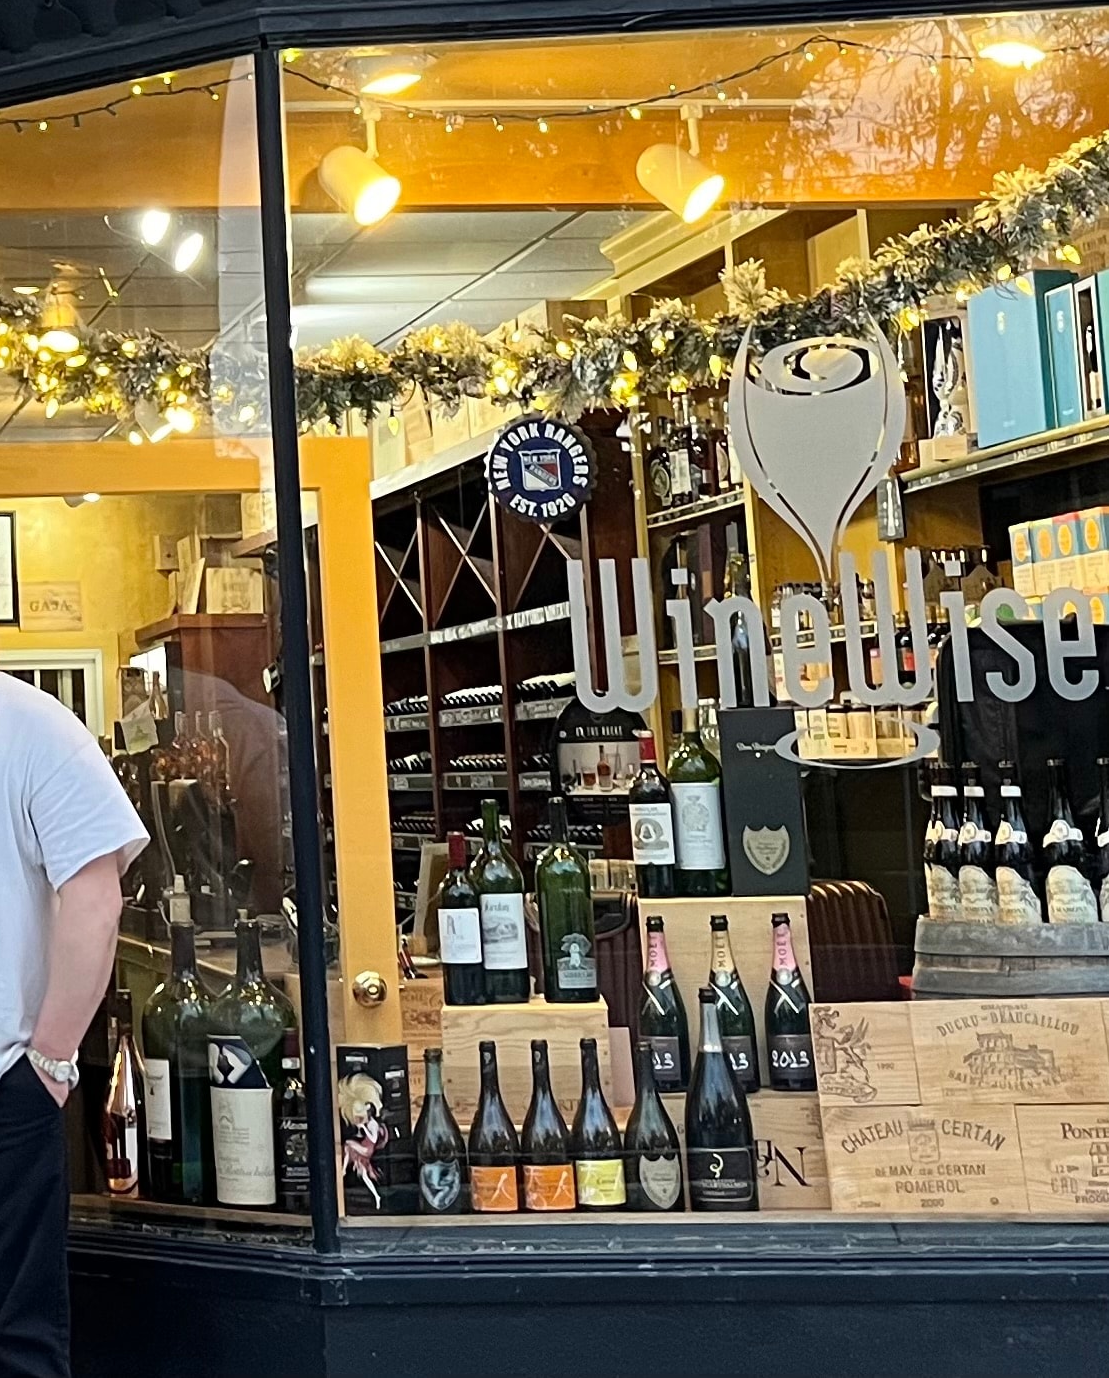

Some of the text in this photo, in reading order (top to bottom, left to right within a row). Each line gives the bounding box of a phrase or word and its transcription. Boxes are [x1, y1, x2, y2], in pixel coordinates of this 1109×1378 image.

[492, 423, 589, 491] NEW YORK RANGERS
[566, 547, 1100, 714] WineWise
[772, 1050, 810, 1068] 2013
[841, 1119, 1006, 1154] CHATEAU CERTAN
[889, 1165, 914, 1177] MAY
[936, 1164, 987, 1177] CERTAN
[895, 1179, 966, 1195] POMEROL
